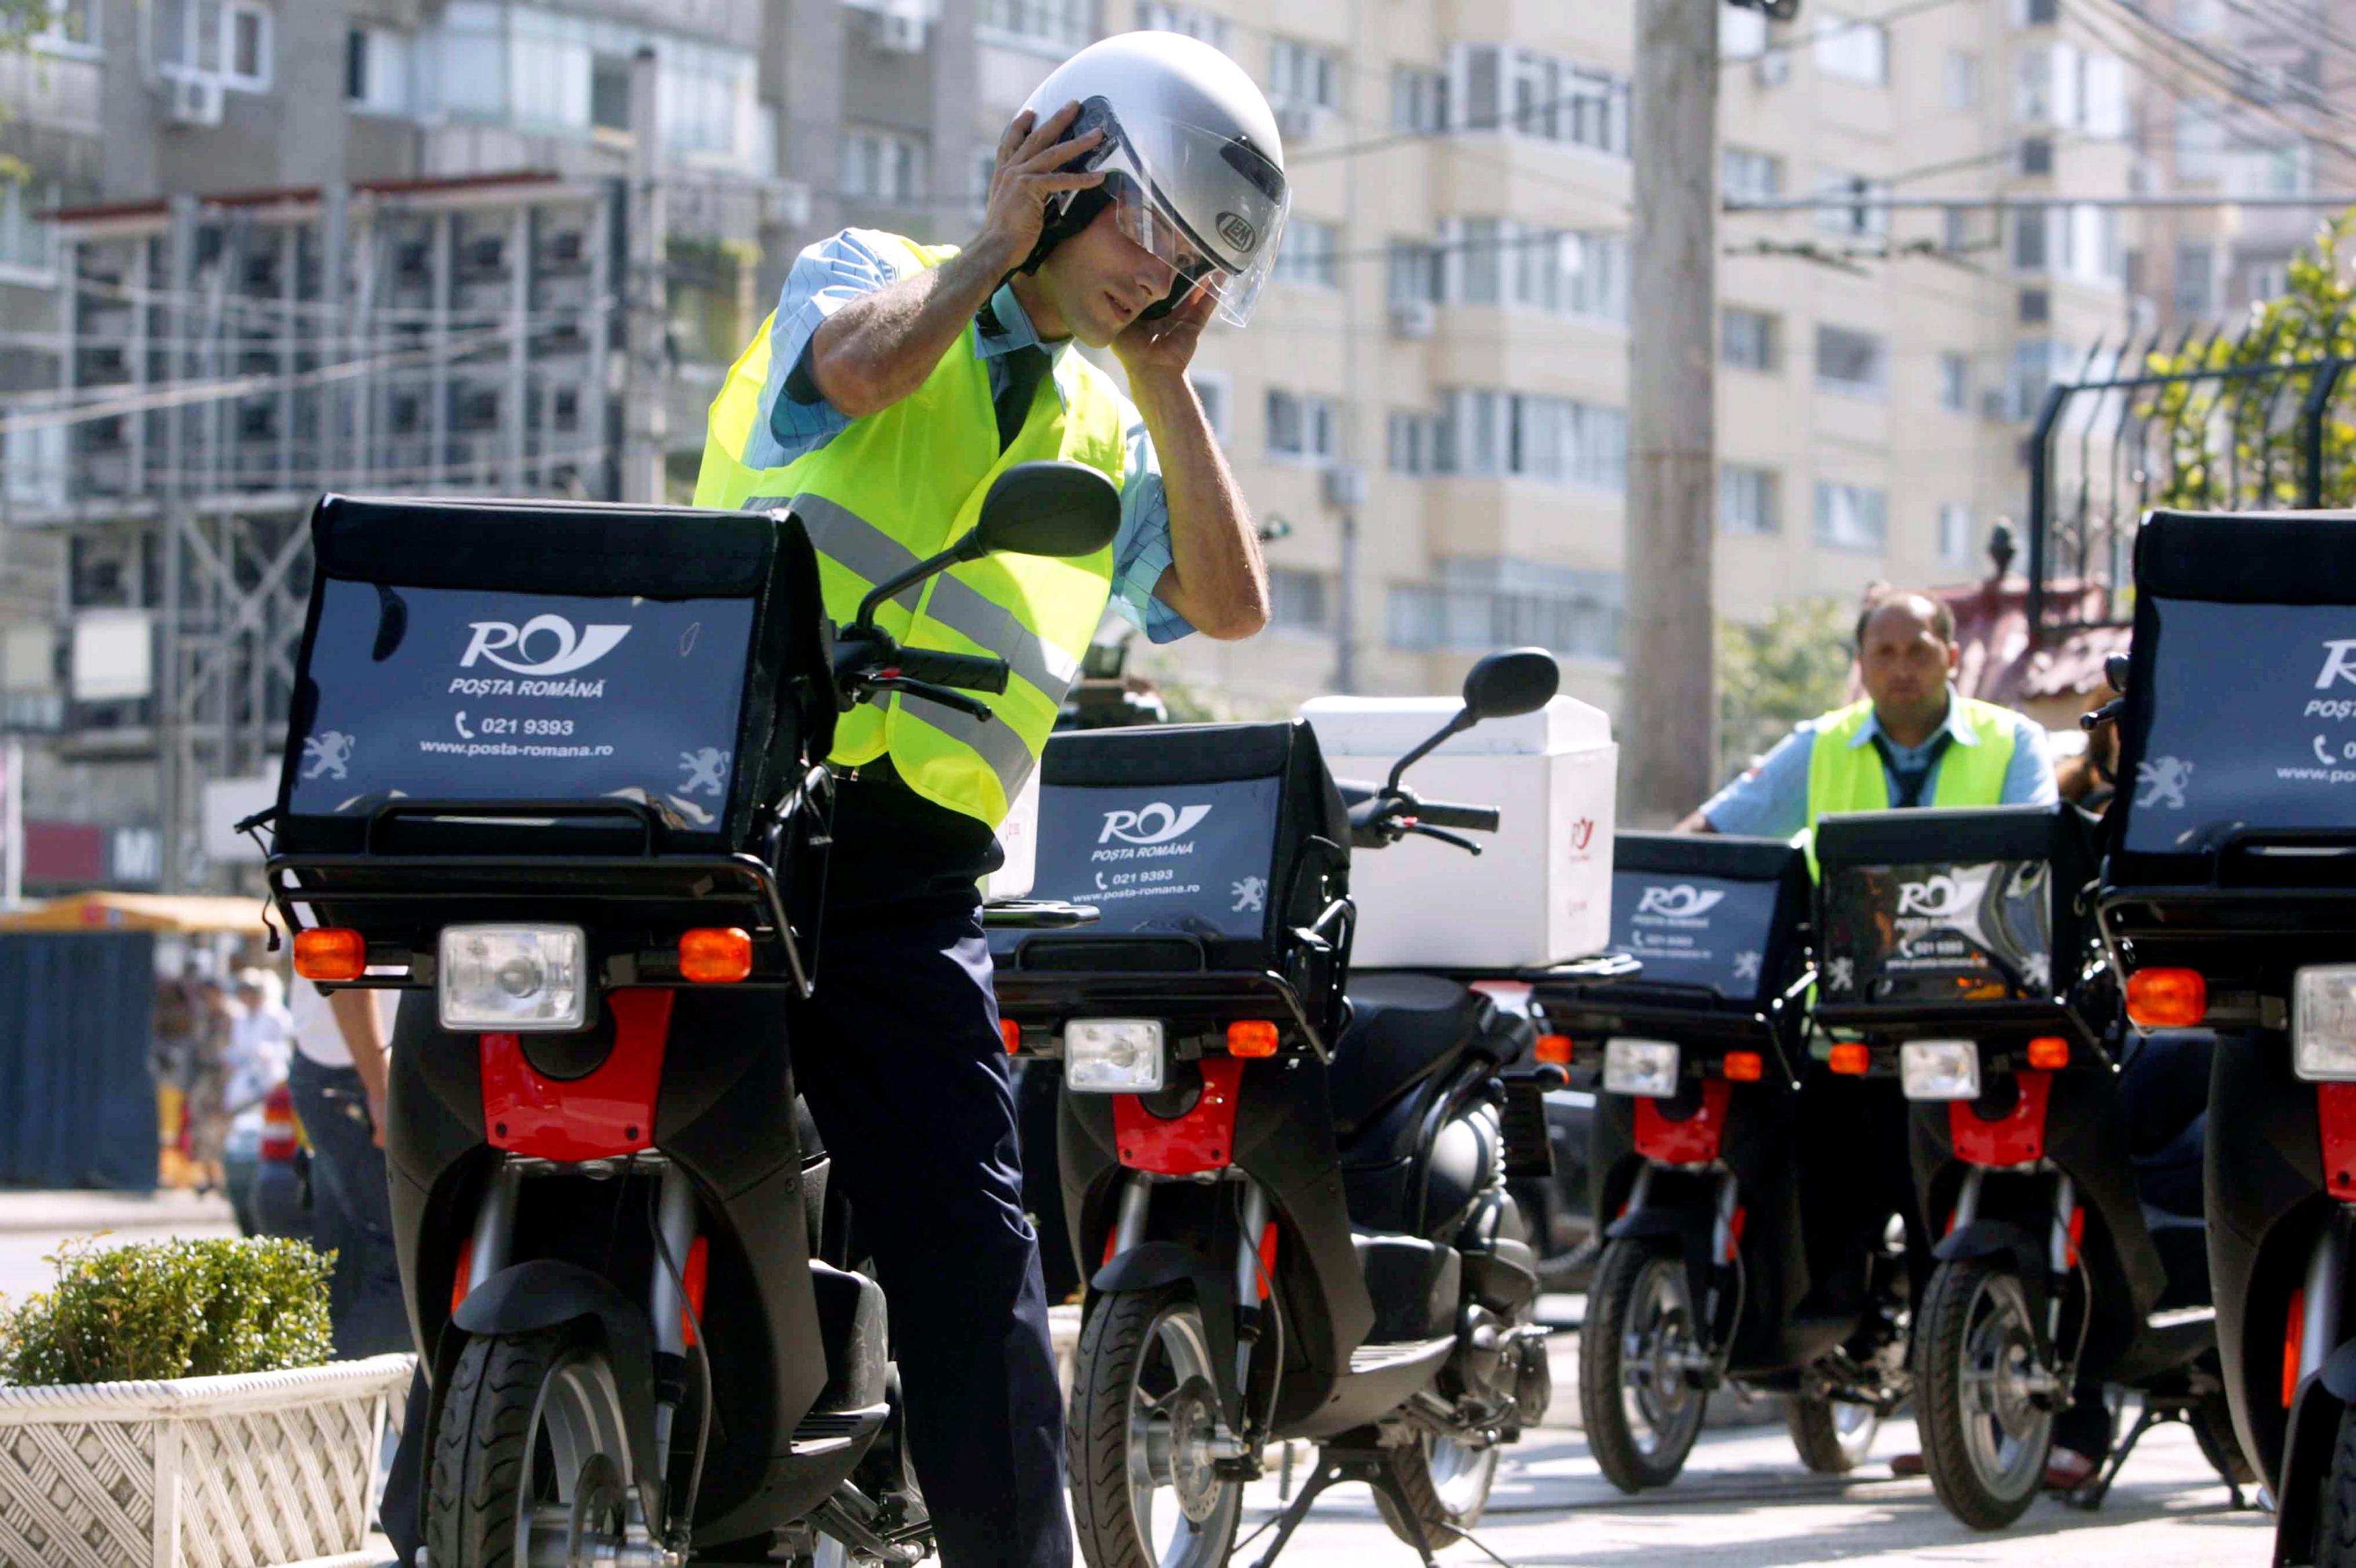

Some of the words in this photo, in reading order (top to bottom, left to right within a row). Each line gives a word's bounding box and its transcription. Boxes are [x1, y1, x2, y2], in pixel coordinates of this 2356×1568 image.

[517, 678, 606, 698] ROMÂNĂ
[481, 717, 518, 734] 021
[523, 719, 574, 736] 9393
[420, 740, 614, 758] www.posta-romana.ro
[1112, 873, 1136, 885] 021
[1140, 869, 1173, 882] 9393
[1073, 884, 1200, 902] www.posta-romana.ro
